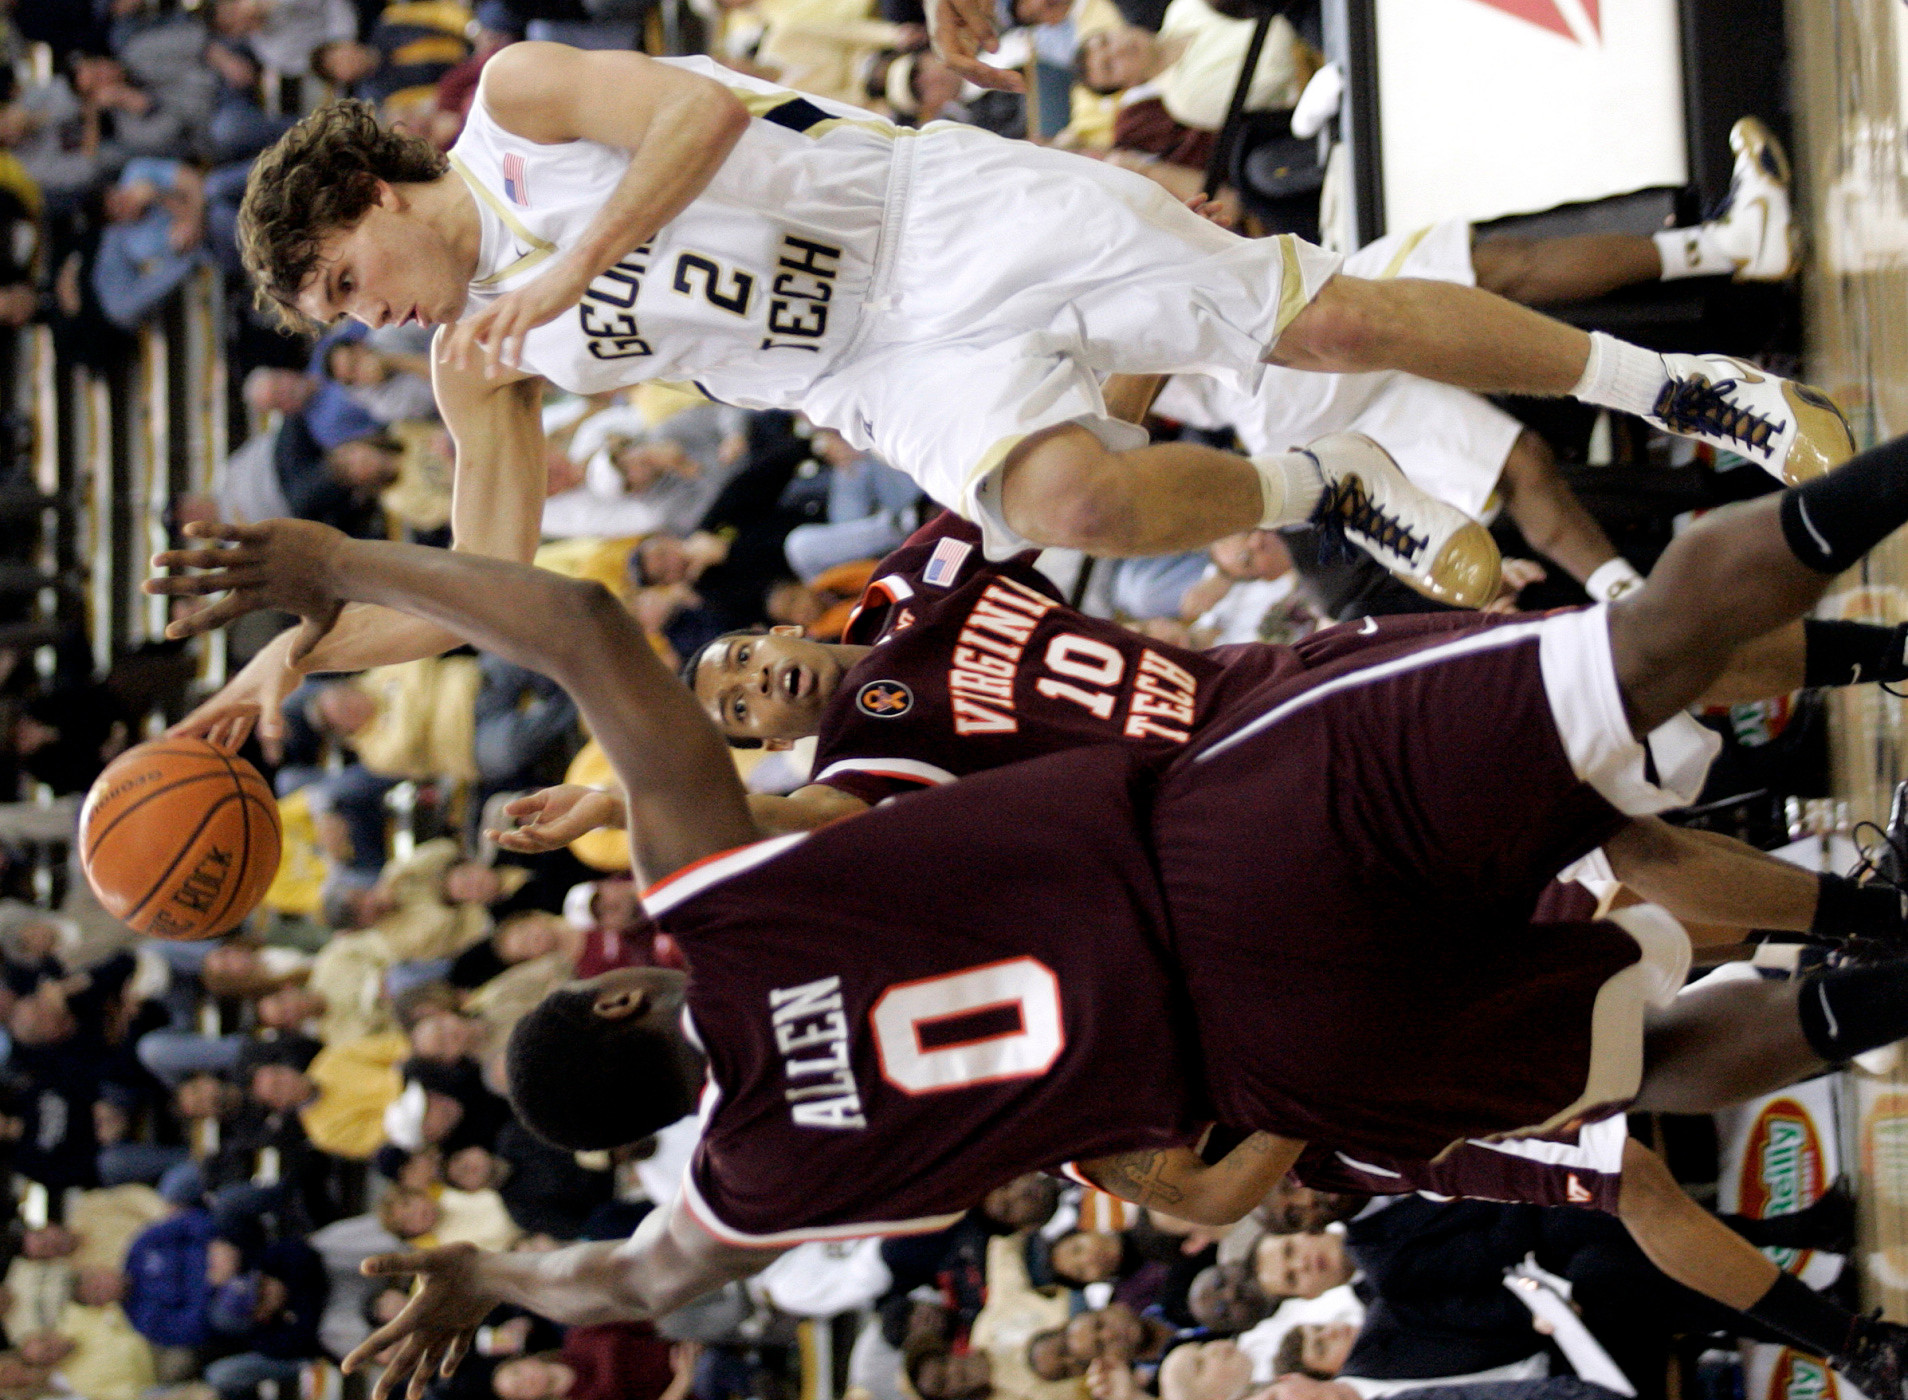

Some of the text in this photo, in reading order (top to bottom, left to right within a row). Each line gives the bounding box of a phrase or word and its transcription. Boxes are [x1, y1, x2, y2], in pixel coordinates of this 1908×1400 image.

[670, 251, 753, 318] 2
[758, 234, 842, 354] TECH
[1034, 632, 1126, 720] 10
[1122, 648, 1198, 743] TECH
[768, 974, 867, 1130] ALLEN
[868, 955, 1066, 1096] 0
